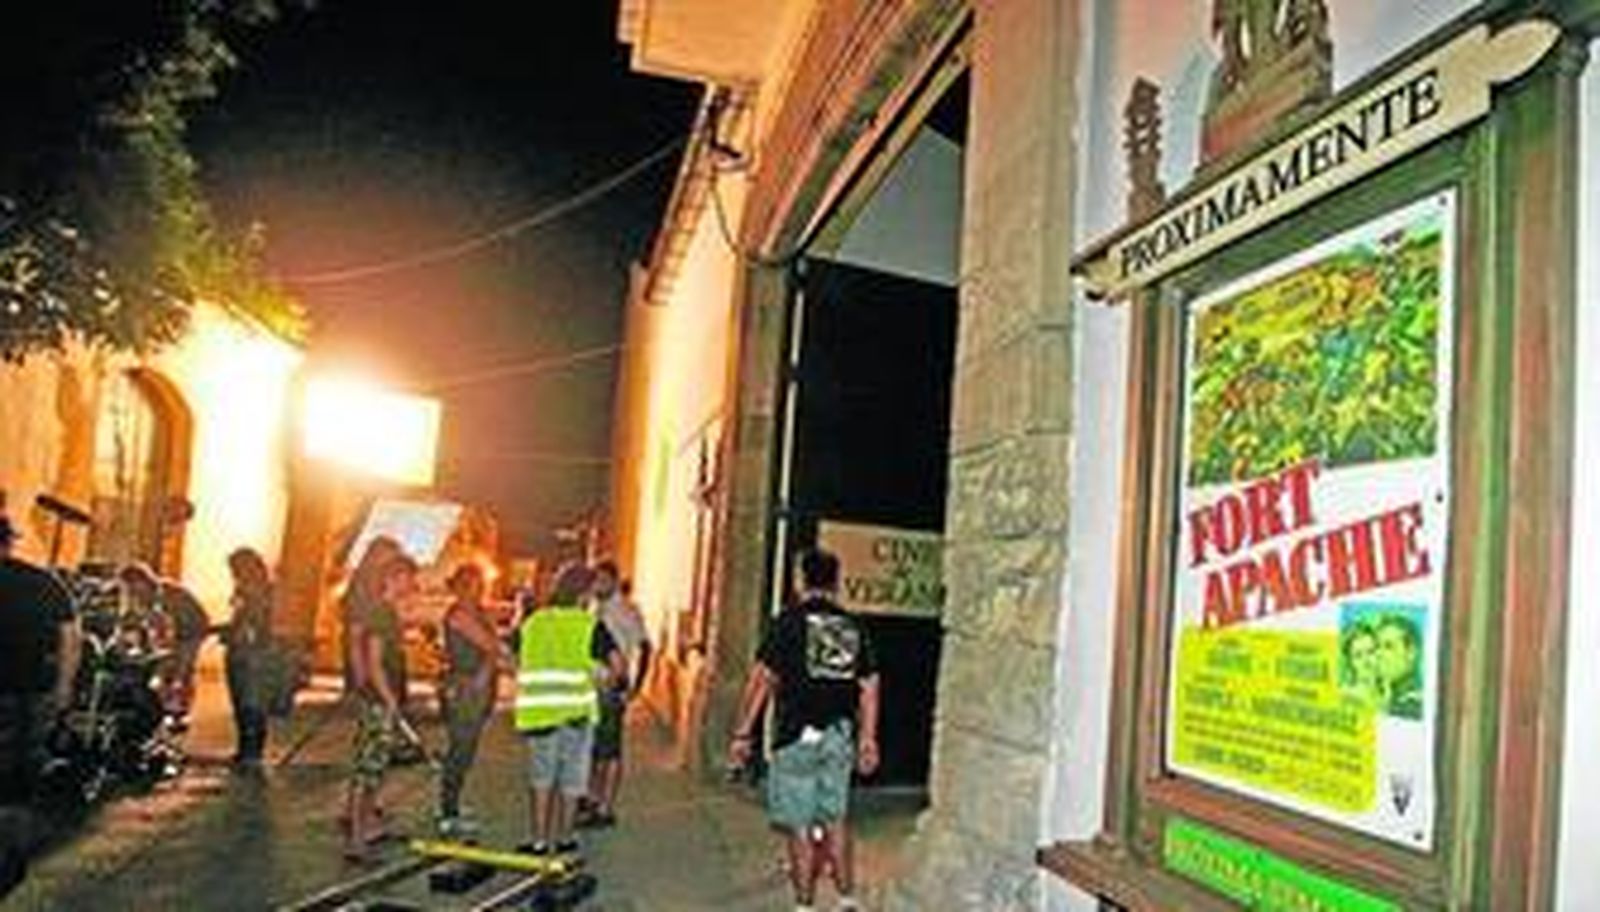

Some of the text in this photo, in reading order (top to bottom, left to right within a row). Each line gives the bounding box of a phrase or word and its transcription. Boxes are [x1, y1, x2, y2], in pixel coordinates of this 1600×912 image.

[1119, 69, 1443, 278] PROXIMAMENTE
[1189, 459, 1320, 568] FORT
[1203, 502, 1431, 629] APACHE
